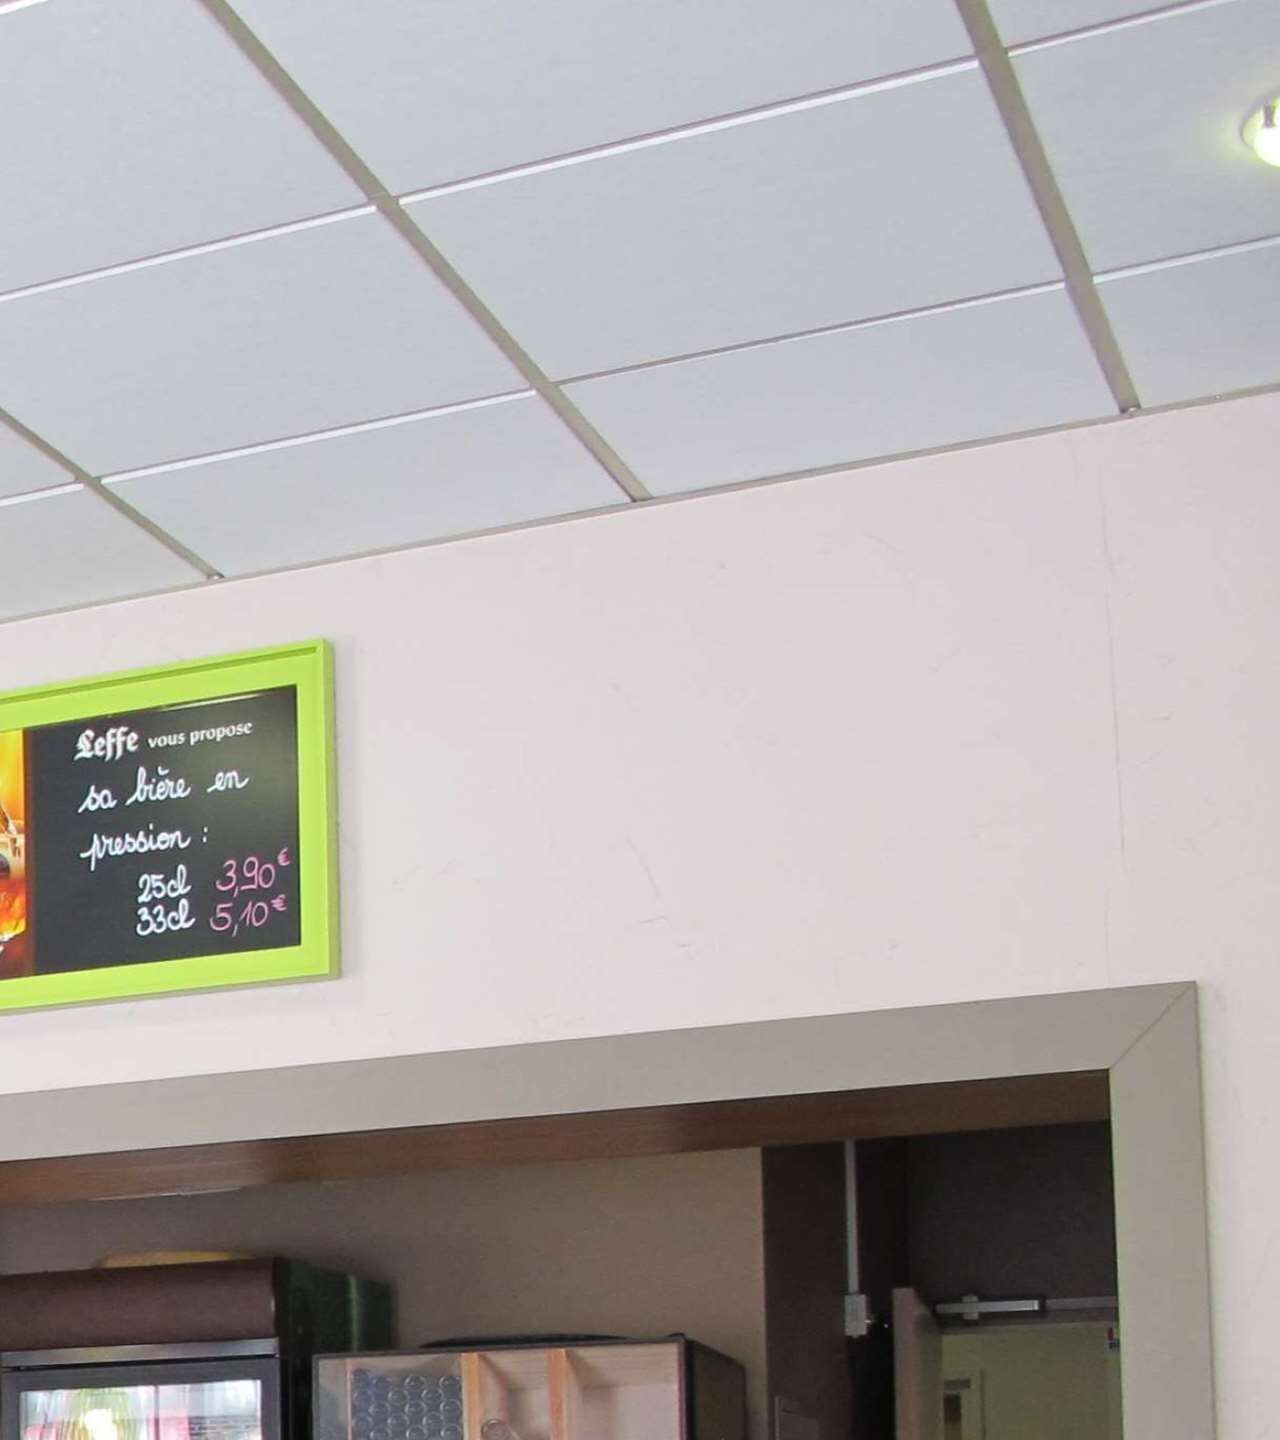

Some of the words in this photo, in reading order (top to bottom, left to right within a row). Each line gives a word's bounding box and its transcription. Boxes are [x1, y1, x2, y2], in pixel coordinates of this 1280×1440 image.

[74, 726, 140, 762] Leffe
[148, 732, 185, 748] vous
[190, 721, 253, 745] propose
[78, 785, 117, 813] sa
[125, 765, 191, 806] bière
[207, 770, 250, 792] en
[80, 823, 191, 871] pression
